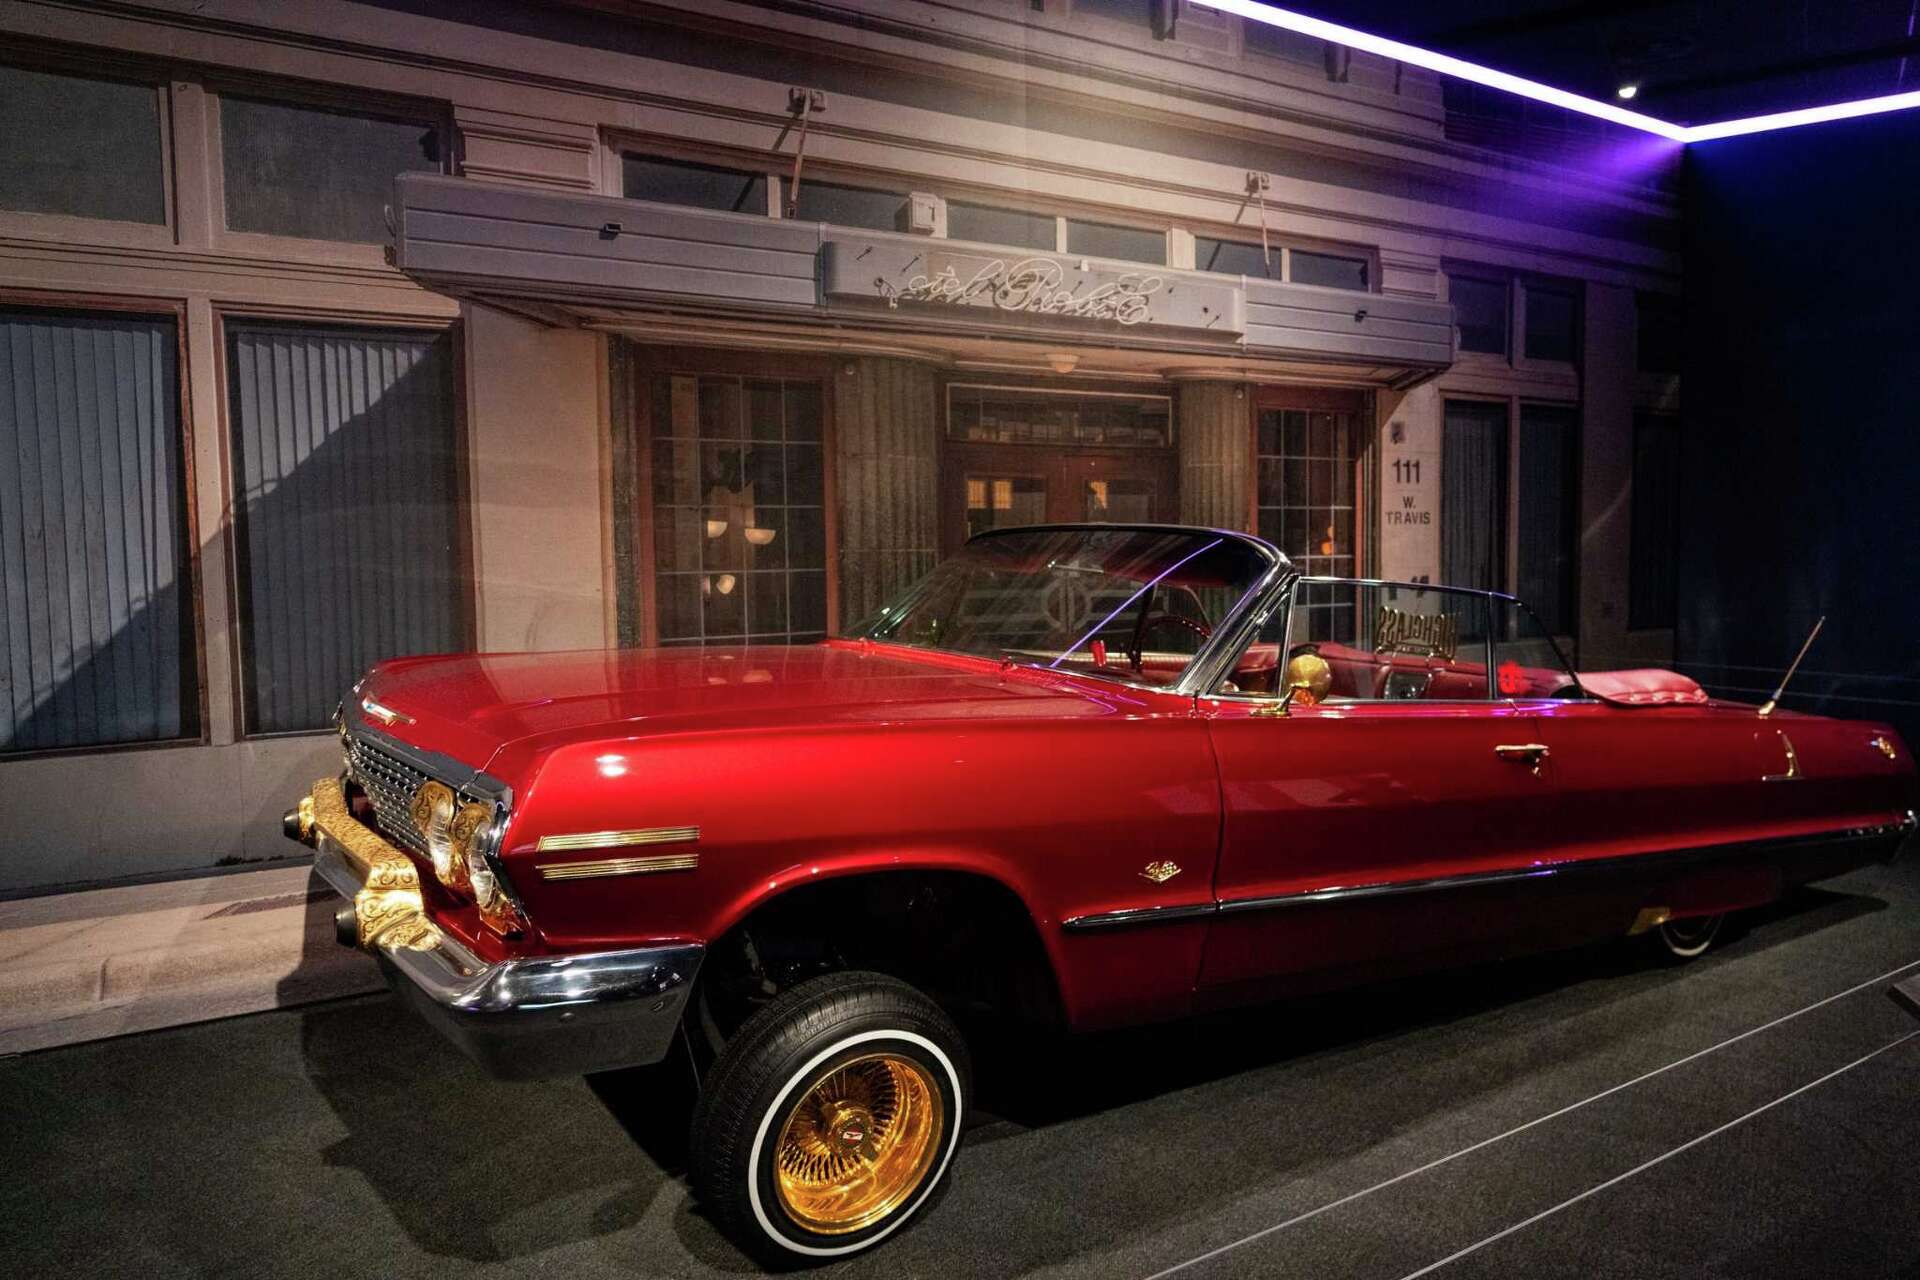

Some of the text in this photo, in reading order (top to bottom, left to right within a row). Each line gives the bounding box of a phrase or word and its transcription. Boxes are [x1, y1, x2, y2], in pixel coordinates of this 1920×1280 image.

[1392, 458, 1420, 484] 111
[1403, 496, 1416, 509] W.
[1385, 511, 1431, 525] TRAVIS
